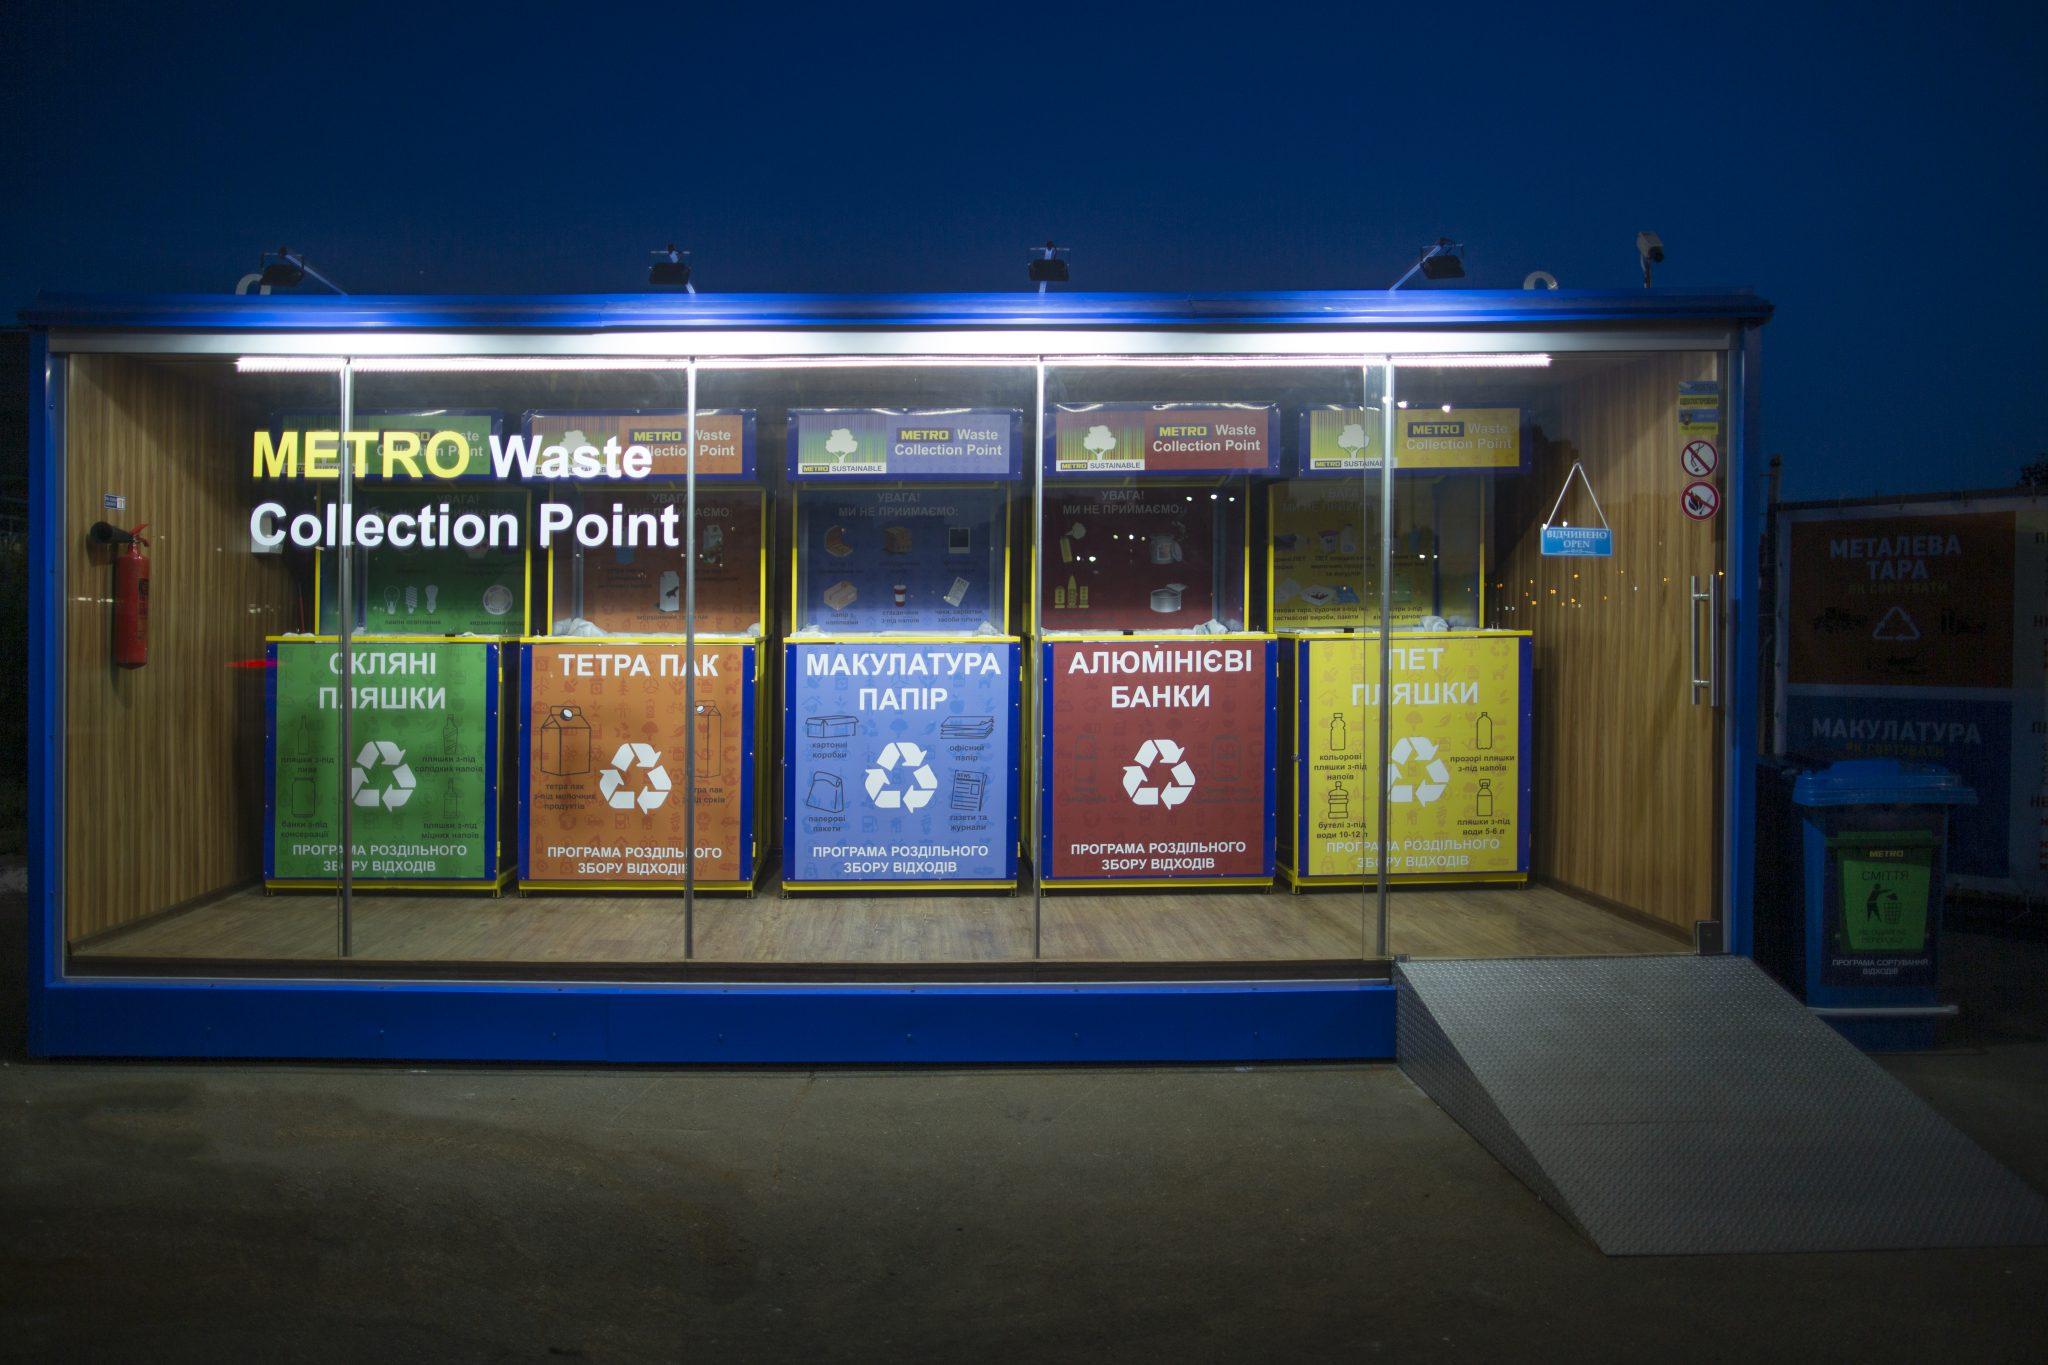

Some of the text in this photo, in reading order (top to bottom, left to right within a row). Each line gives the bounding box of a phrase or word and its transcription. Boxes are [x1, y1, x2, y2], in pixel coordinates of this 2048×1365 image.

[901, 429, 998, 441] METRO Waste
[1159, 424, 1257, 437] METRO Waste
[1412, 423, 1508, 435] METRO Waste
[634, 431, 682, 442] METRO
[894, 444, 1002, 456] Collection Point
[1152, 439, 1260, 452] Collection Point
[1406, 438, 1512, 450] Collection Point
[253, 431, 653, 479] METRO Waste
[700, 444, 735, 457] Point
[1344, 460, 1384, 468] SUSTAINA
[877, 492, 921, 503] УВАГА!
[1102, 490, 1145, 501] УВАГА!
[1062, 504, 1080, 515] МИ
[1080, 504, 1100, 515] НЕ
[250, 503, 680, 547] Collection Point
[1547, 530, 1608, 540] ВІДЧИНЕНО
[1563, 539, 1590, 549] OPEN
[1829, 535, 1962, 559] МЕТАЛЕВА
[1866, 559, 1929, 580] ТАРА
[806, 652, 1002, 676] МАКУЛАТУРА
[1068, 650, 1253, 674] АЛЮМІНІЄВІ
[1388, 647, 1444, 671] ПЕТ
[558, 654, 651, 677] ТЕТРА
[859, 688, 948, 711] ПАПІР
[1111, 685, 1210, 708] БАНКИ
[1811, 718, 1983, 744] МАКУЛАТУРА
[811, 741, 848, 750] картонні
[949, 744, 985, 754] офісний
[812, 751, 848, 760] коробки
[955, 754, 979, 762] папір
[1319, 753, 1362, 762] кольорові
[1450, 755, 1482, 763] прозорі
[1347, 764, 1368, 772] з-під
[1457, 764, 1507, 773] з-під напоїв
[808, 815, 846, 824] паперові
[1318, 820, 1367, 830] бутелі з-під
[1456, 817, 1511, 826] пляшки з-під
[950, 823, 987, 832] журнали
[1462, 828, 1483, 836] води
[1485, 827, 1498, 835] 5-6
[1316, 832, 1337, 840] води
[1339, 830, 1361, 839] 10-12
[370, 844, 467, 857] РОЗДІЛЬНОГО
[1070, 841, 1247, 855] ПРОГРАМА РОЗДІЛЬНОГО
[1404, 838, 1500, 851] РОЗДІЛЬНОГО
[547, 847, 723, 860] ПРОГРАМА РОЗДІЛЬОГО
[812, 846, 989, 859] ПРОГРАМА РОЗДІЛЬНОГО
[1869, 850, 1904, 858] METRO
[323, 860, 436, 873] ЗБРУ ВІДХОДІВ
[1101, 858, 1215, 871] ЗБОРУ ВІДХОДІВ
[1405, 855, 1469, 868] ВІДХОДІВ
[578, 862, 623, 875] ЗБОРУ
[843, 862, 957, 875] ЗБОРУ ВІДХОДІВ
[1861, 869, 1910, 882] СМІТТЯ
